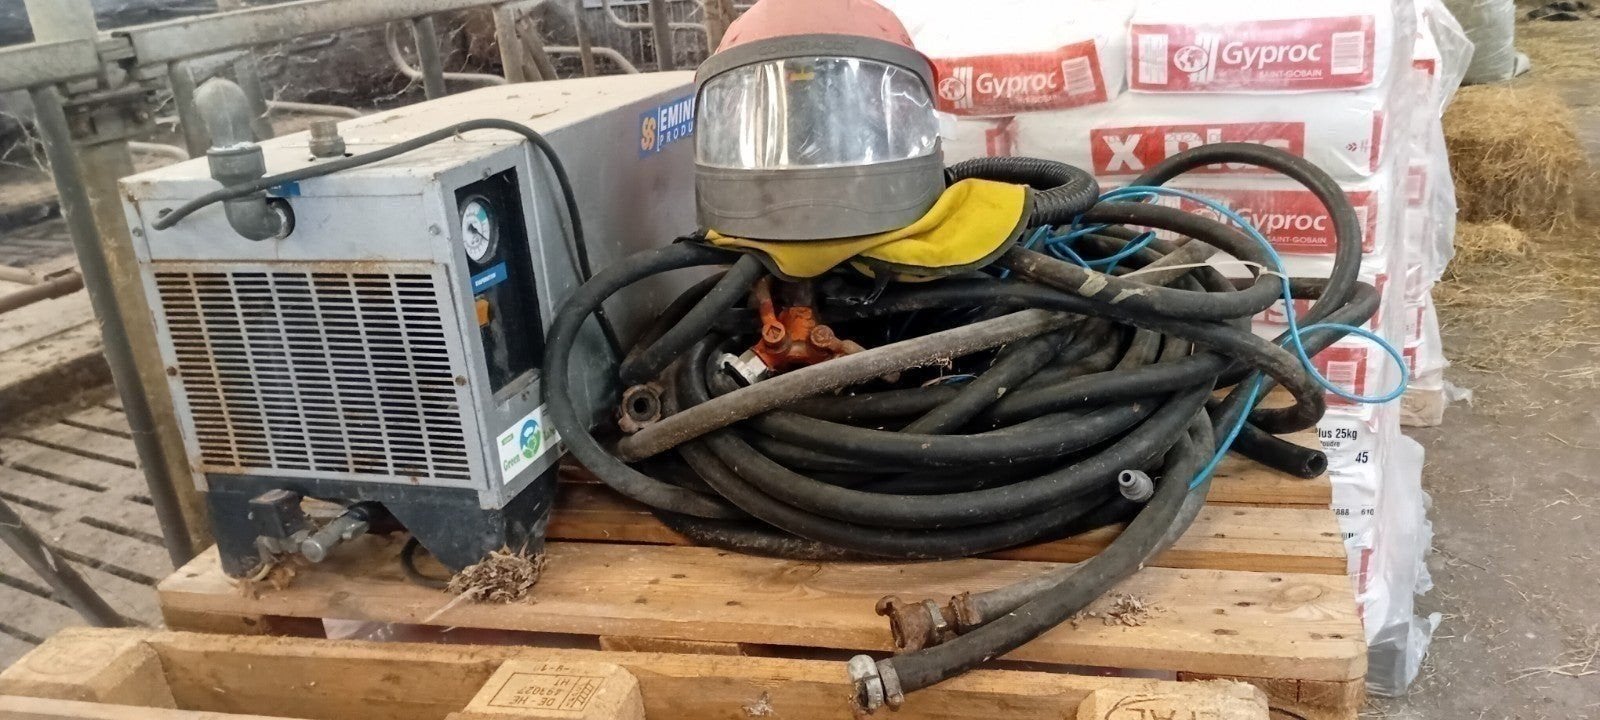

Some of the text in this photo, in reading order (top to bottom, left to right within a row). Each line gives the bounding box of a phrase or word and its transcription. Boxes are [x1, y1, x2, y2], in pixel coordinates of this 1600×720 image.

[1222, 41, 1323, 71] Gyproc
[976, 71, 1057, 98] Gyproc
[1102, 133, 1145, 171] X
[1316, 428, 1358, 440] lus 25kg
[1355, 451, 1369, 464] 45
